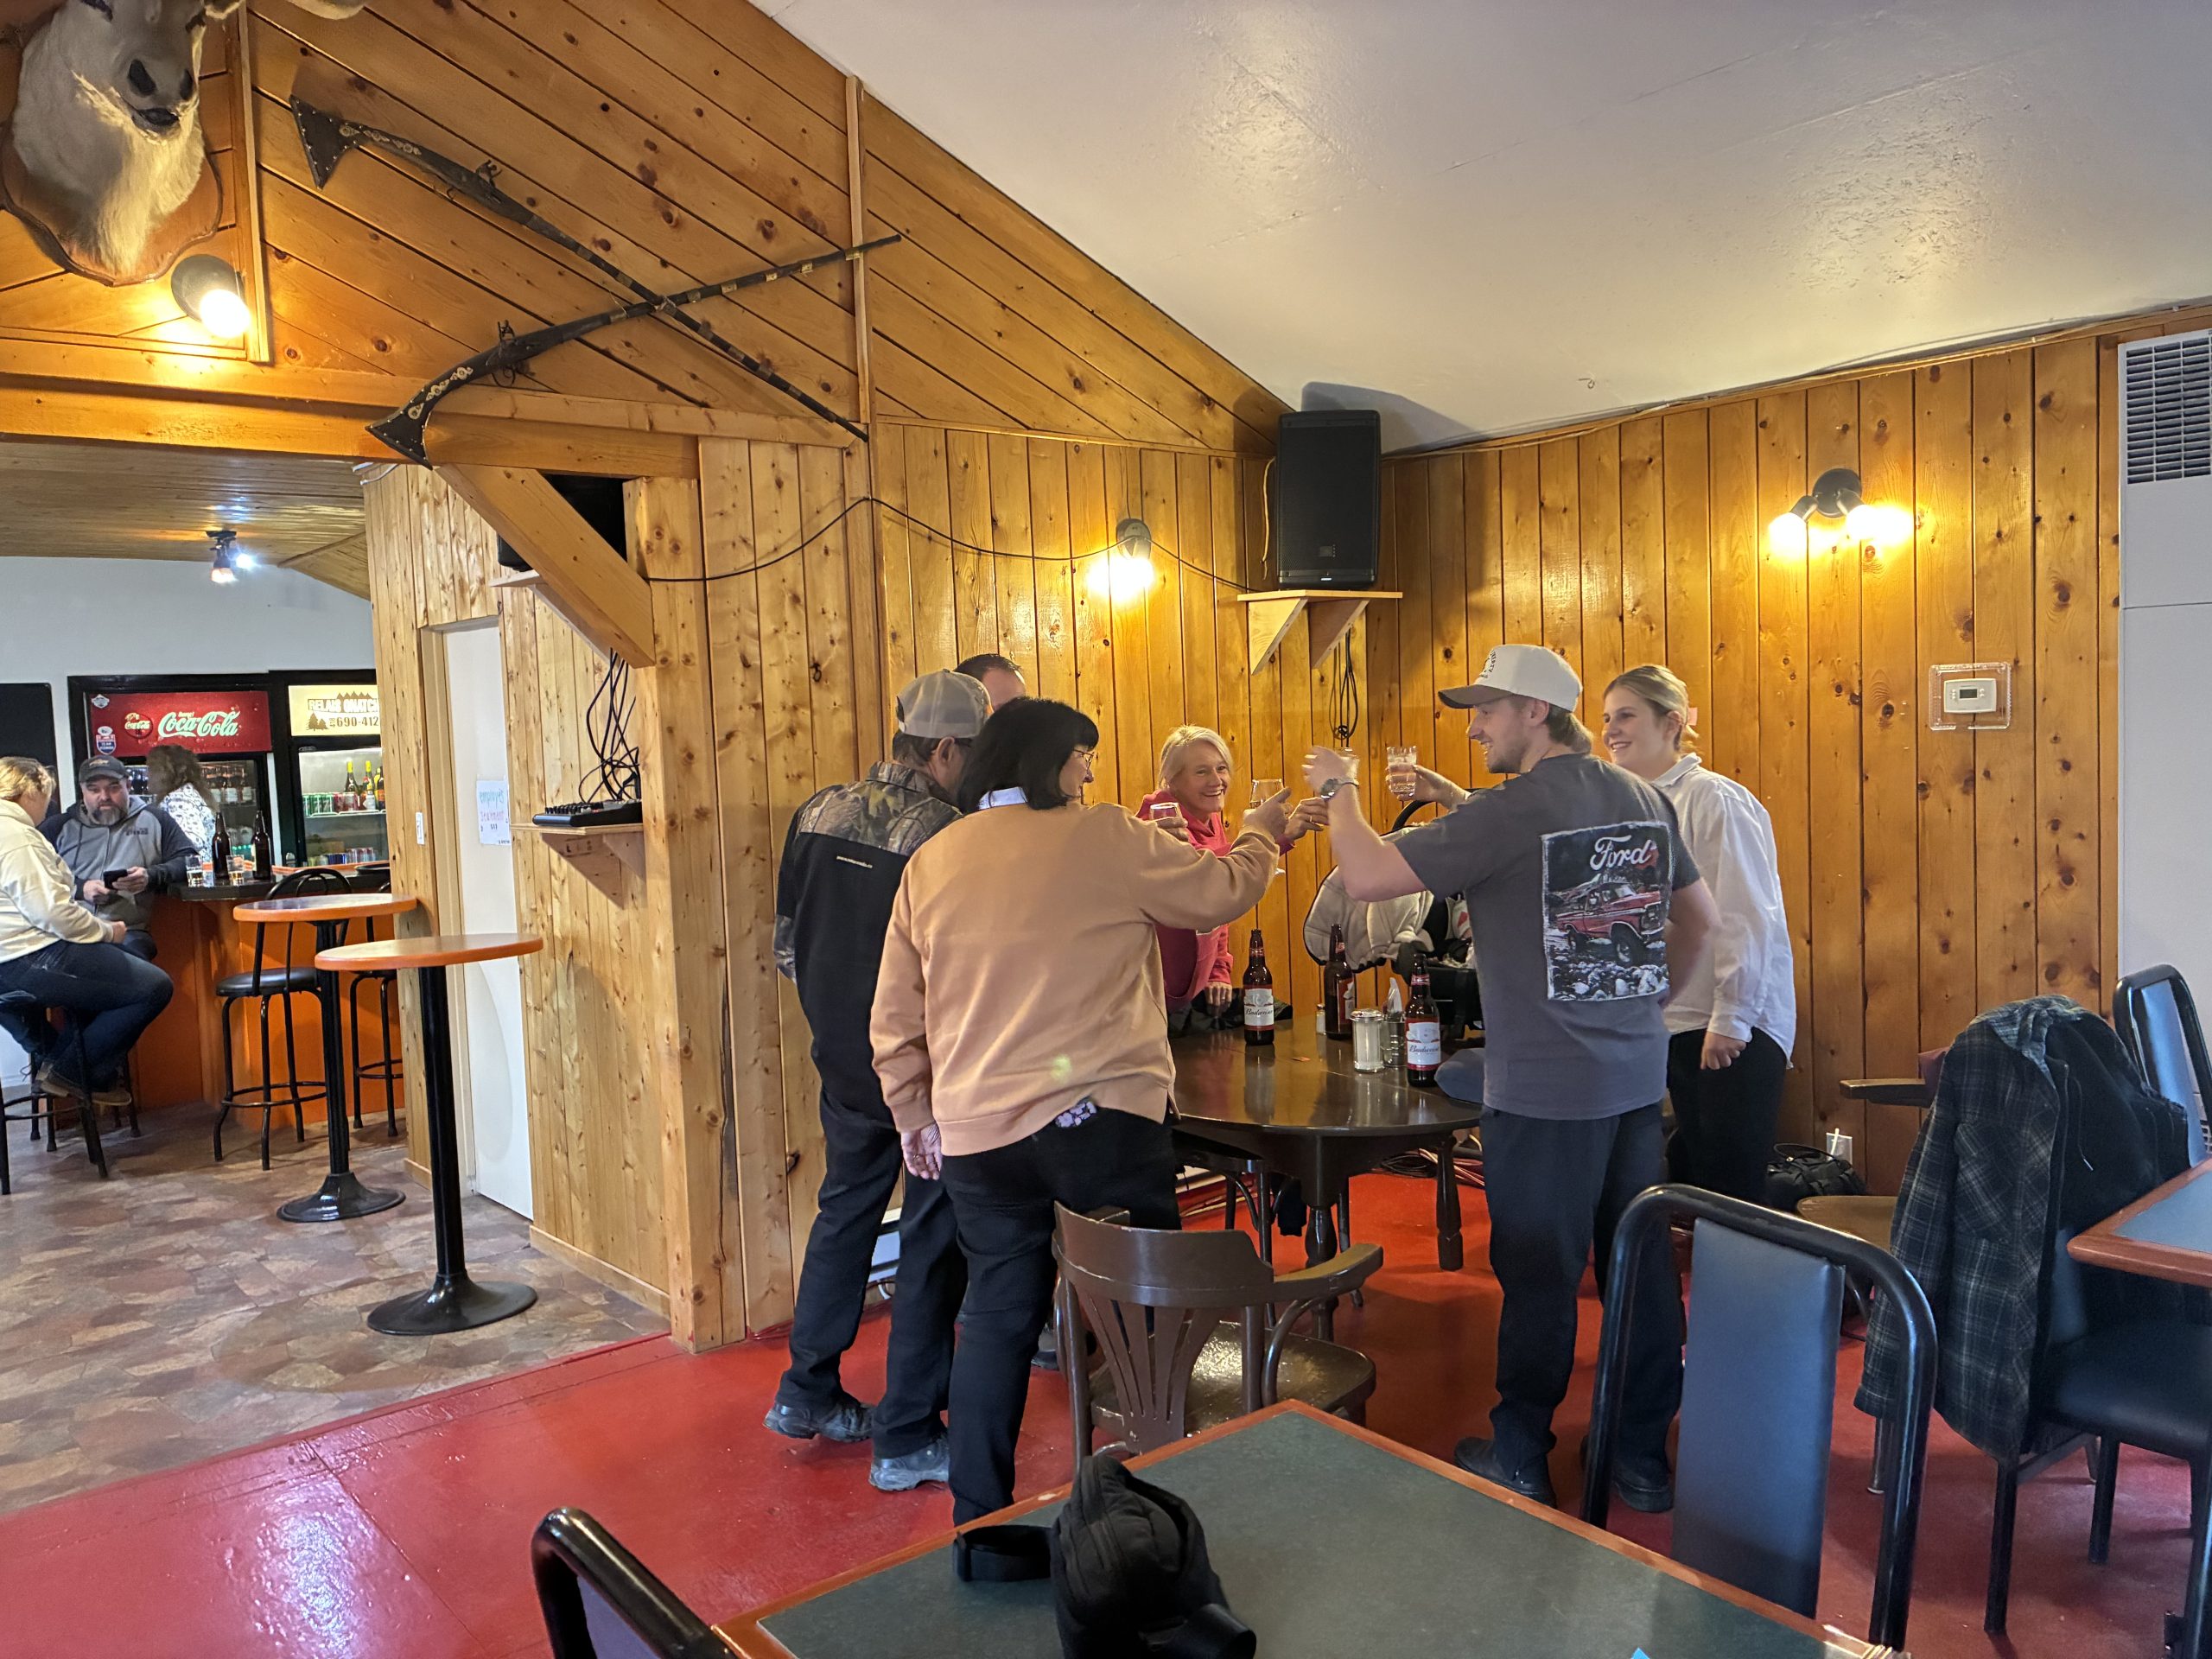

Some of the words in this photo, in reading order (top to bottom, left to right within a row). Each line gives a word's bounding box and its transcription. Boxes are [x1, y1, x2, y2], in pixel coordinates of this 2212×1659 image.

[308, 698, 341, 713] RELAIS
[158, 711, 241, 738] Coca-Cola
[1590, 835, 1652, 871] Ford
